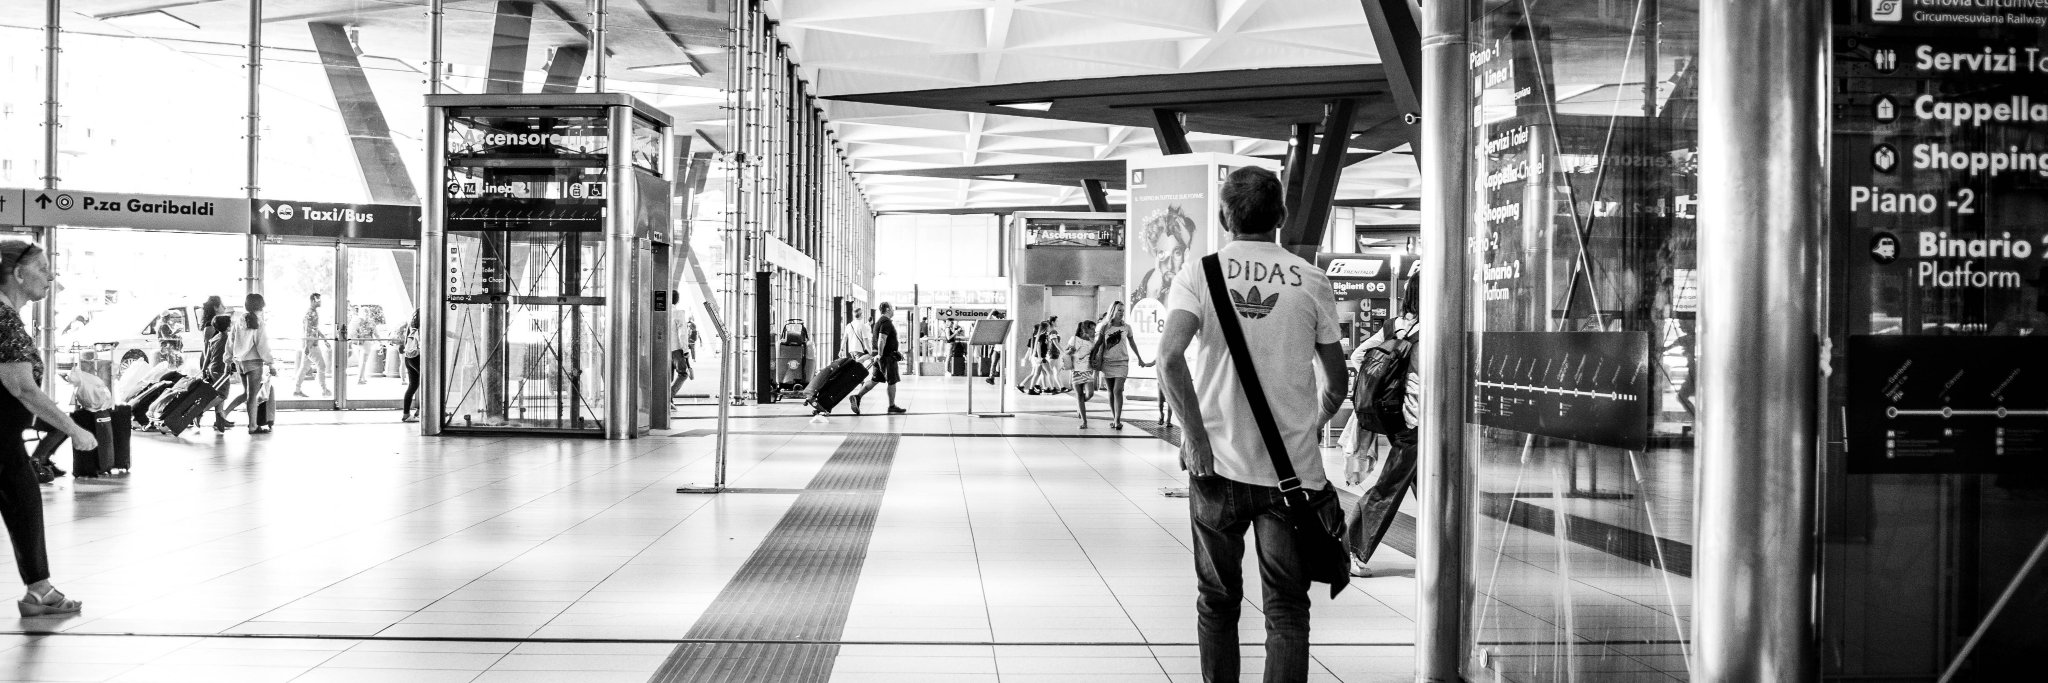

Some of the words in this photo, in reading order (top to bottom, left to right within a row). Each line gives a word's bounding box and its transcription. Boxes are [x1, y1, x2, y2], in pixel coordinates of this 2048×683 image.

[1914, 10, 2004, 23] Circumvesuviana
[2007, 12, 2047, 27] Railway
[1470, 48, 1491, 70] Piano
[1916, 44, 2016, 71] Servizi
[1485, 67, 1507, 89] Linea
[1508, 59, 1513, 78] 1
[1915, 95, 2048, 127] Cappella
[463, 130, 562, 146] Ascensore
[1484, 131, 1510, 156] Servizi
[1510, 125, 1529, 147] Toilet
[1518, 153, 1545, 180] Chel
[83, 196, 121, 212] P.za
[127, 198, 214, 217] Garibaldi
[1483, 200, 1520, 224] Shopping
[1850, 186, 1937, 213] Piano
[1947, 188, 1975, 214] -2
[302, 206, 374, 223] Taxi/Bus
[1041, 230, 1096, 240] Ascensore
[1097, 230, 1110, 240] Lift
[1467, 236, 1489, 255] Pio
[1490, 231, 1499, 250] -2
[1919, 231, 2032, 258] Binario
[1227, 258, 1302, 287] DIDAS
[1484, 261, 1513, 281] Binario
[1513, 259, 1520, 279] 2
[1919, 261, 2021, 287] Platform
[1333, 282, 1365, 291] Biglietti
[1484, 281, 1510, 301] Platform
[955, 309, 989, 317] Stazione
